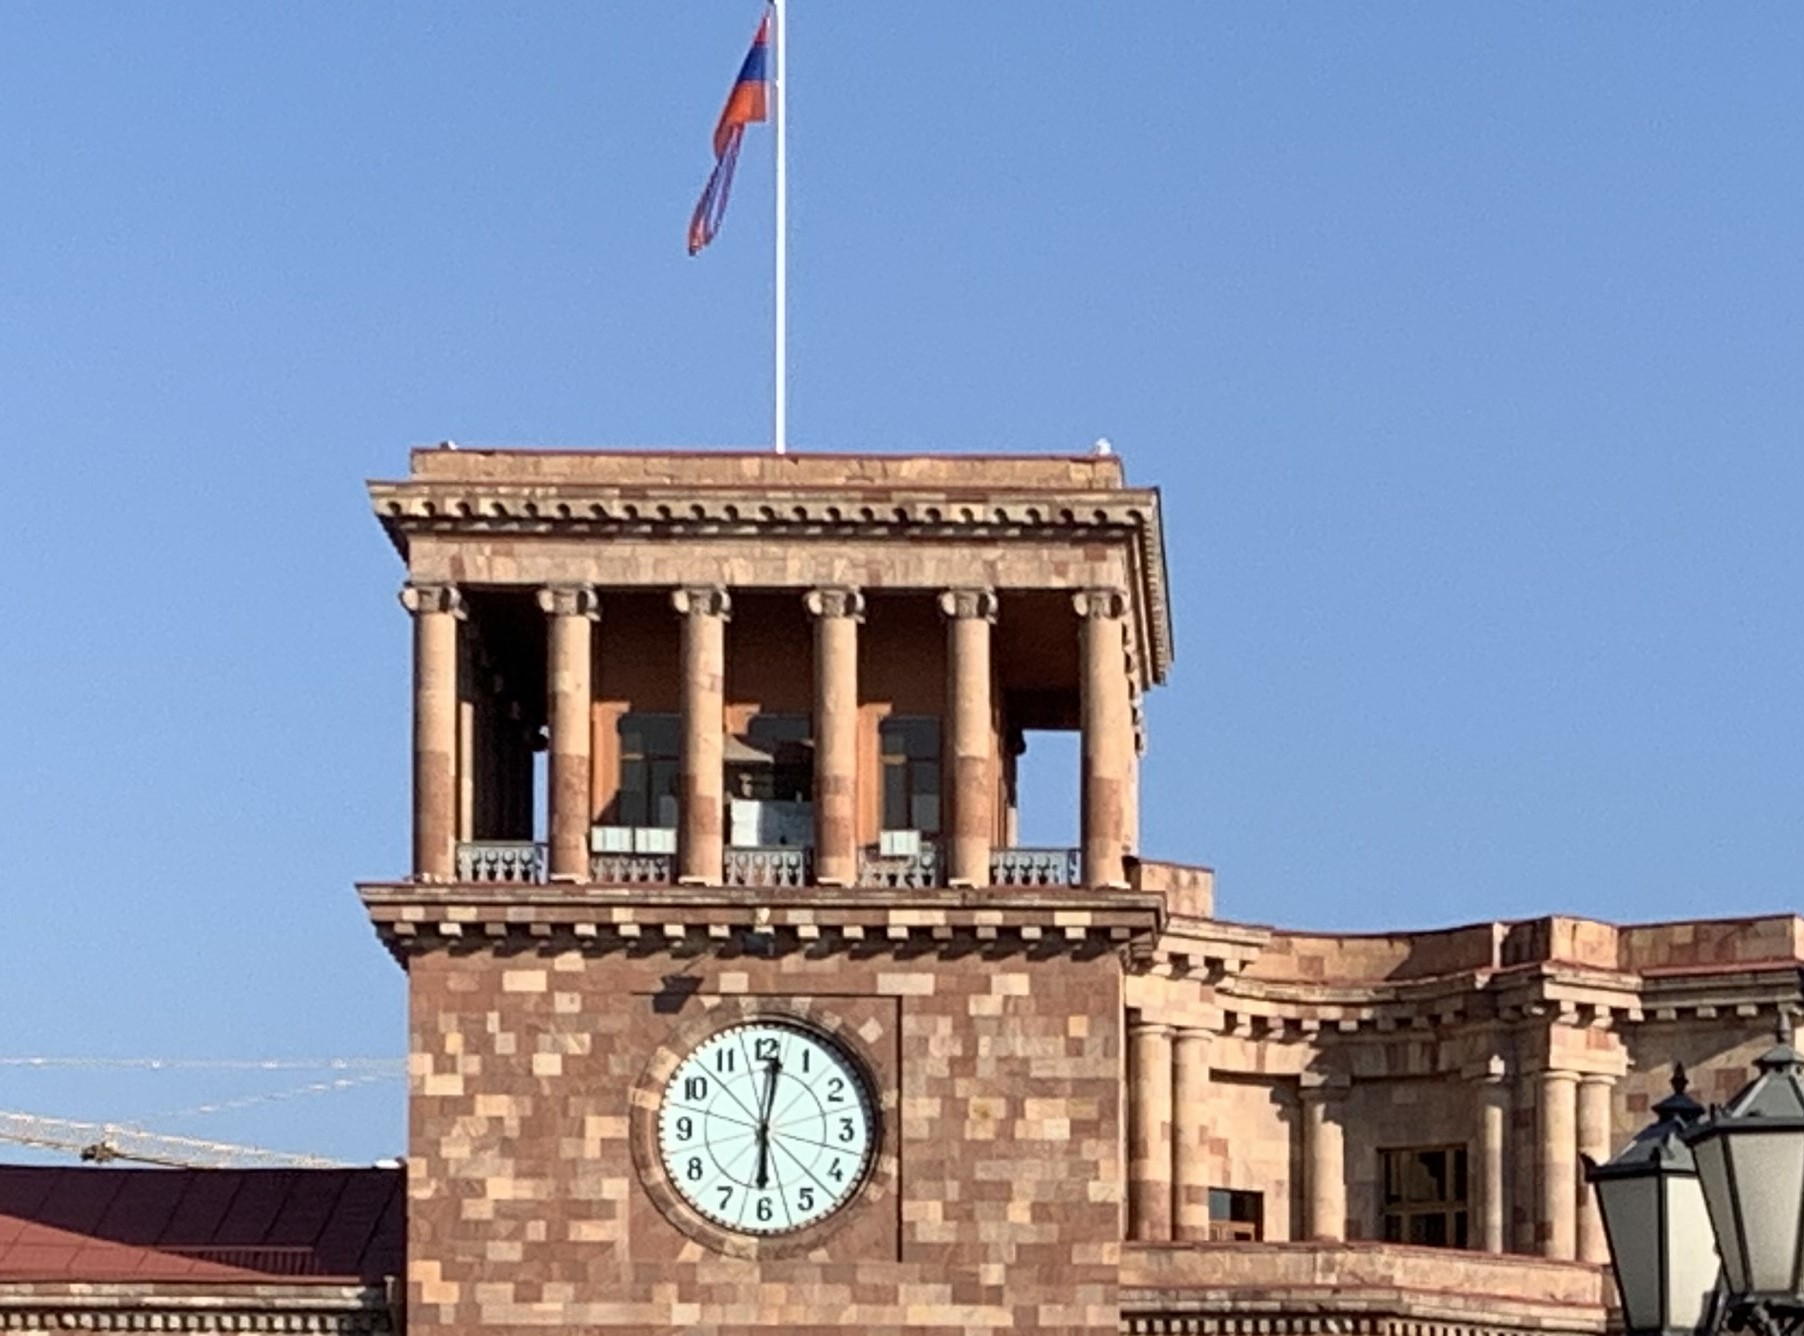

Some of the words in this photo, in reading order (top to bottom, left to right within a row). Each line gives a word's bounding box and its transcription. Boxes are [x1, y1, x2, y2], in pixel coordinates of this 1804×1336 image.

[716, 1048, 735, 1072] 11
[754, 1037, 780, 1062] 12
[802, 1048, 810, 1073] 1
[684, 1077, 707, 1101] 10
[827, 1078, 845, 1102] 2
[676, 1117, 693, 1141] 9
[838, 1118, 855, 1142] 3
[687, 1157, 703, 1181] 8
[828, 1158, 843, 1182] 4
[717, 1186, 734, 1210] 7
[756, 1197, 773, 1221] 6
[797, 1188, 814, 1211] 5
